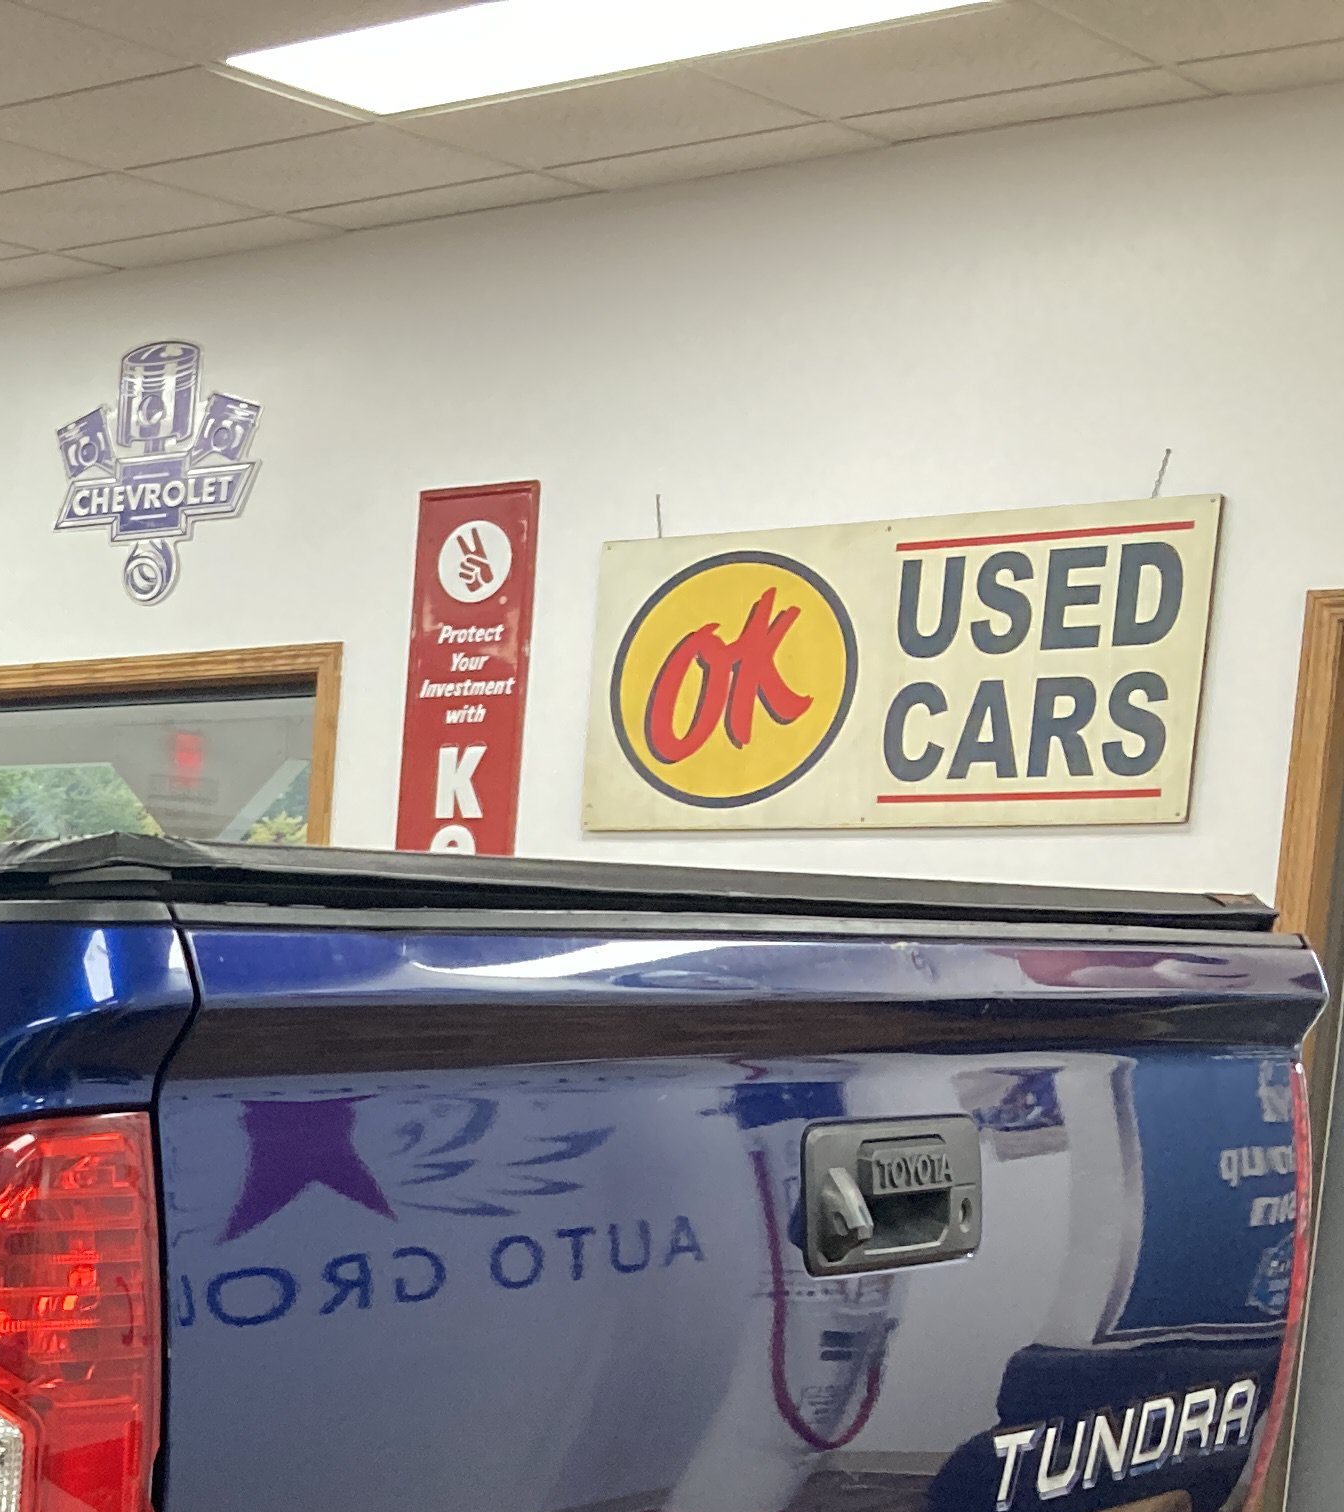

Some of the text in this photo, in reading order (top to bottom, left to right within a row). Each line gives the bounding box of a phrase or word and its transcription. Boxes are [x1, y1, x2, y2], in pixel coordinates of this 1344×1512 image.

[72, 476, 234, 517] CHEVROLET
[896, 541, 1185, 660] USED
[438, 623, 505, 645] Protect
[450, 652, 489, 673] Your
[644, 586, 814, 765] OK
[419, 677, 516, 699] Investment
[445, 703, 487, 725] with
[883, 670, 1169, 783] CARS
[876, 1153, 953, 1189] TOYOTA
[993, 1377, 1261, 1512] TUNDRA
